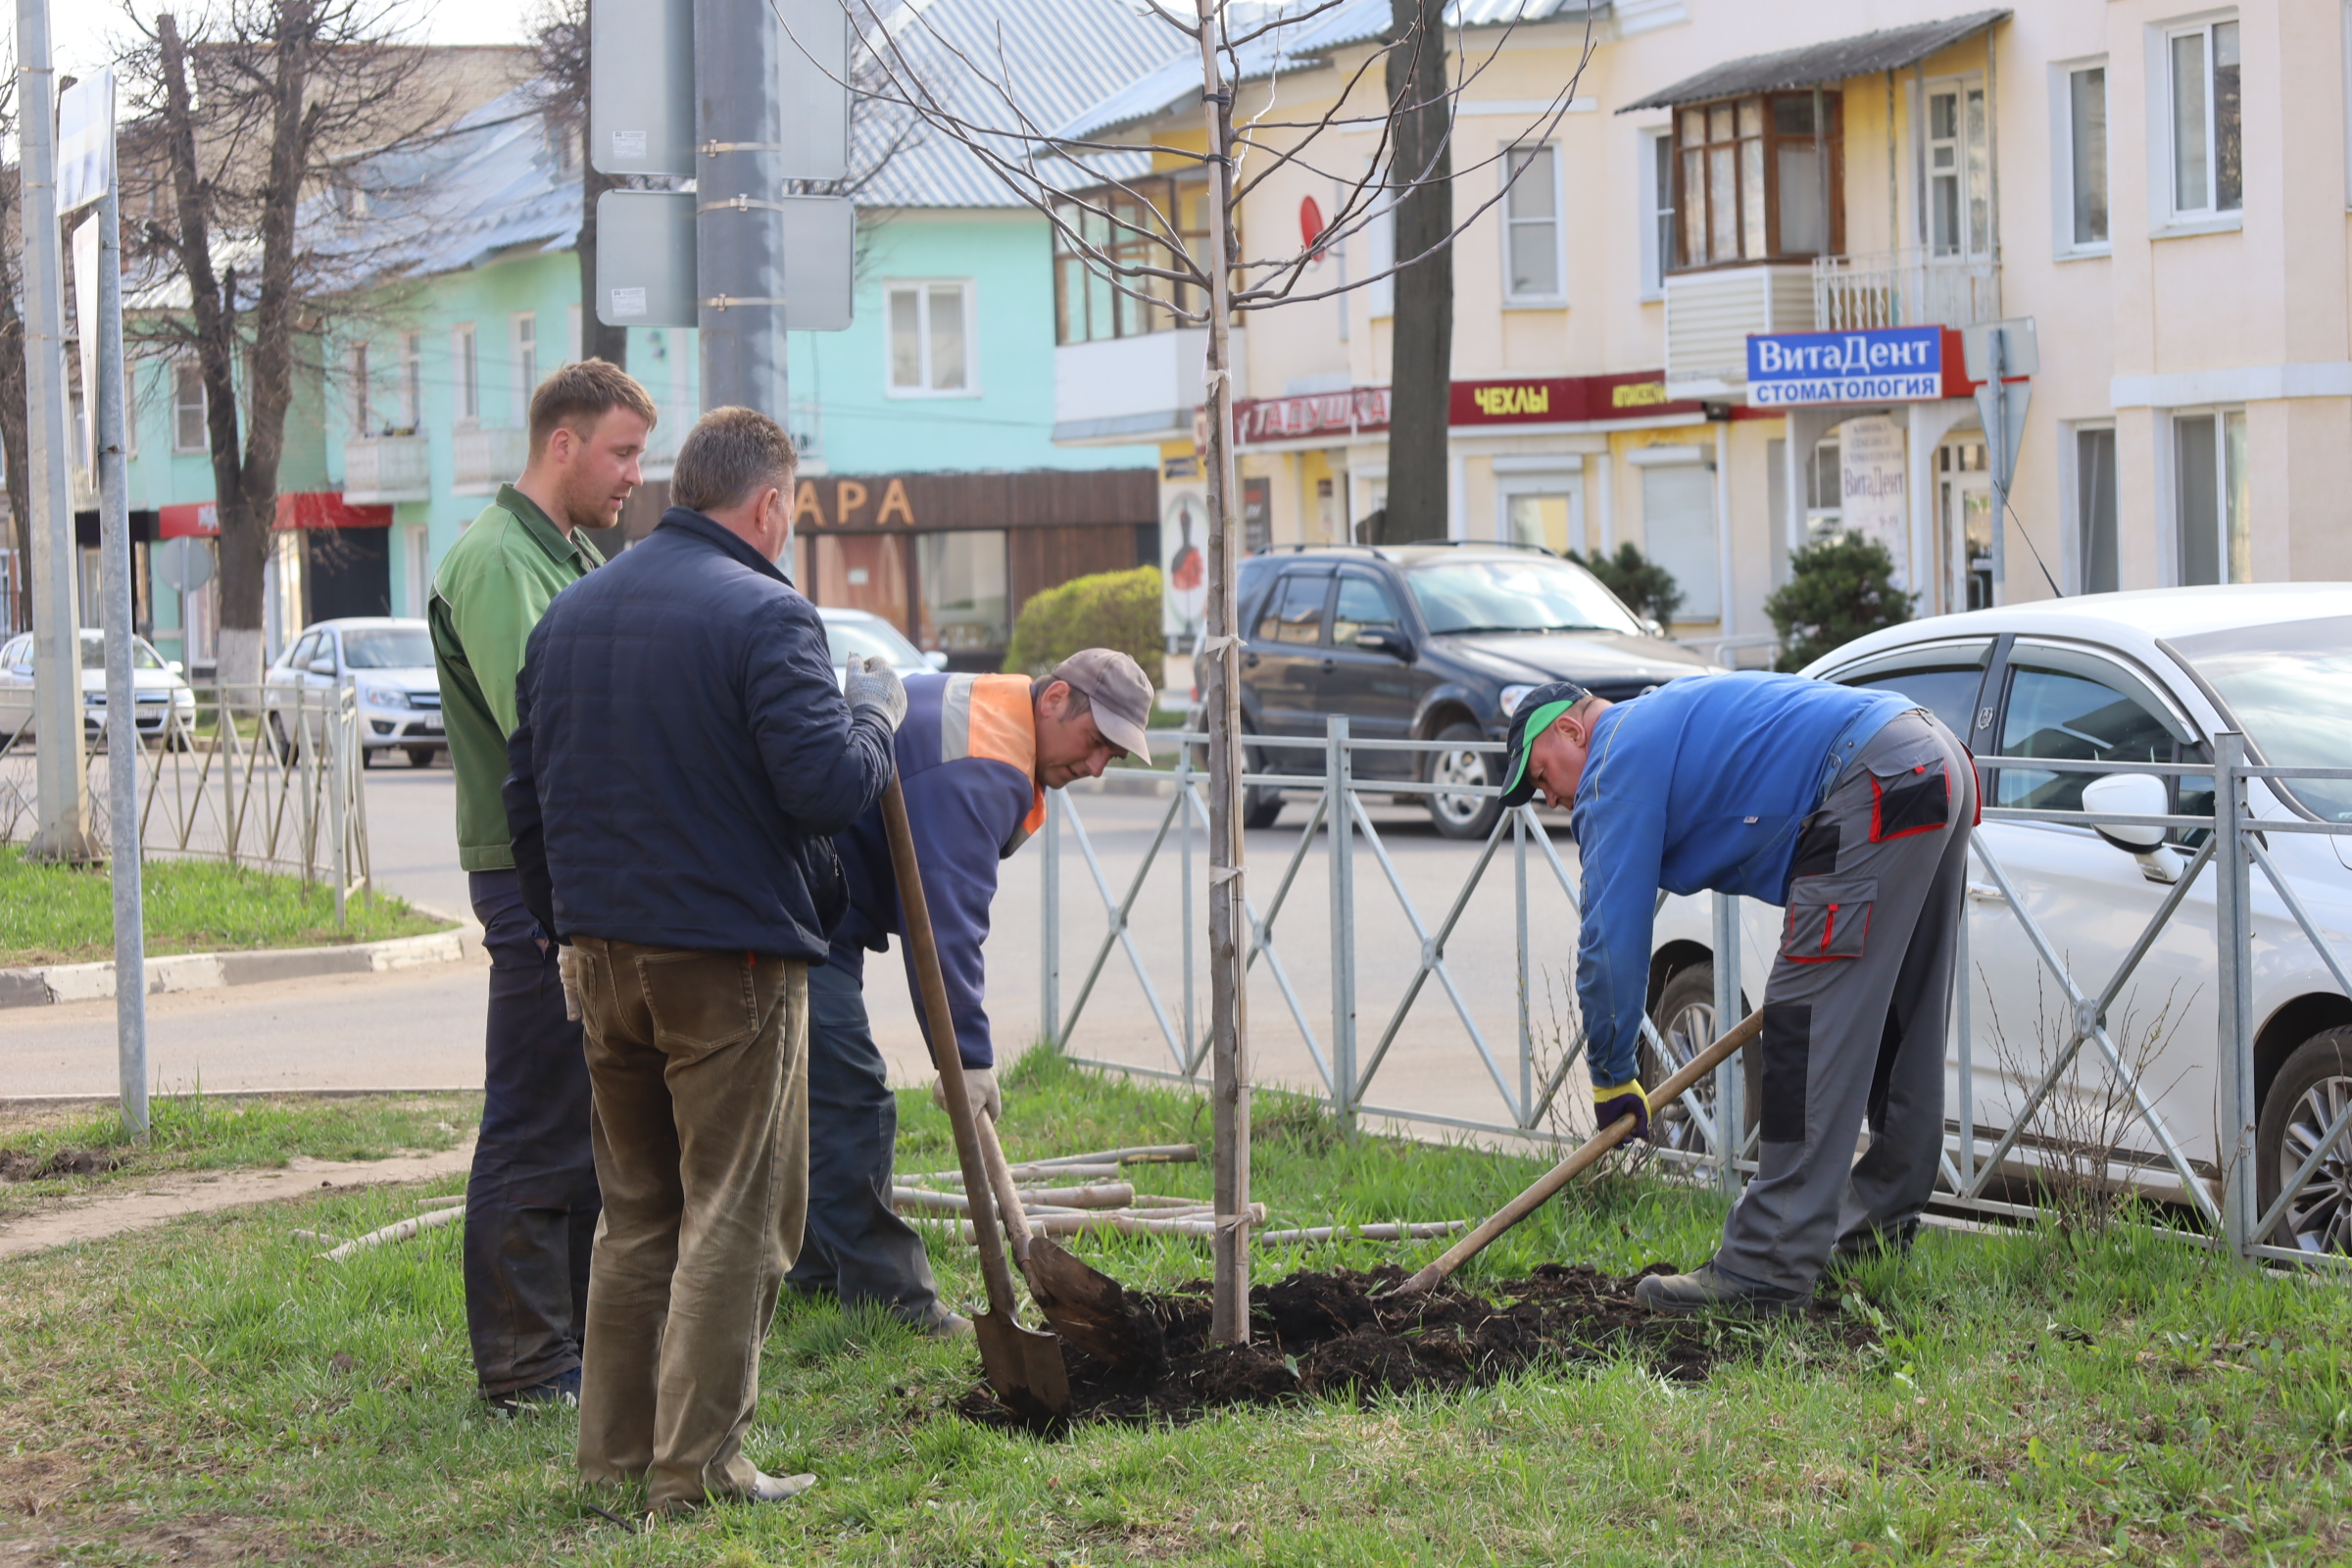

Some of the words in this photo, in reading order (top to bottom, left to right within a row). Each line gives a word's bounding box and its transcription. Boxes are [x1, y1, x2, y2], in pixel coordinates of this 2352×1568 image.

[1757, 336, 1932, 375] ВитаДент
[1474, 385, 1549, 415] ЧЕХЛЫ
[1757, 377, 1936, 403] СТОМАТОЛОГИЯ
[1844, 466, 1904, 502] ВитаДент
